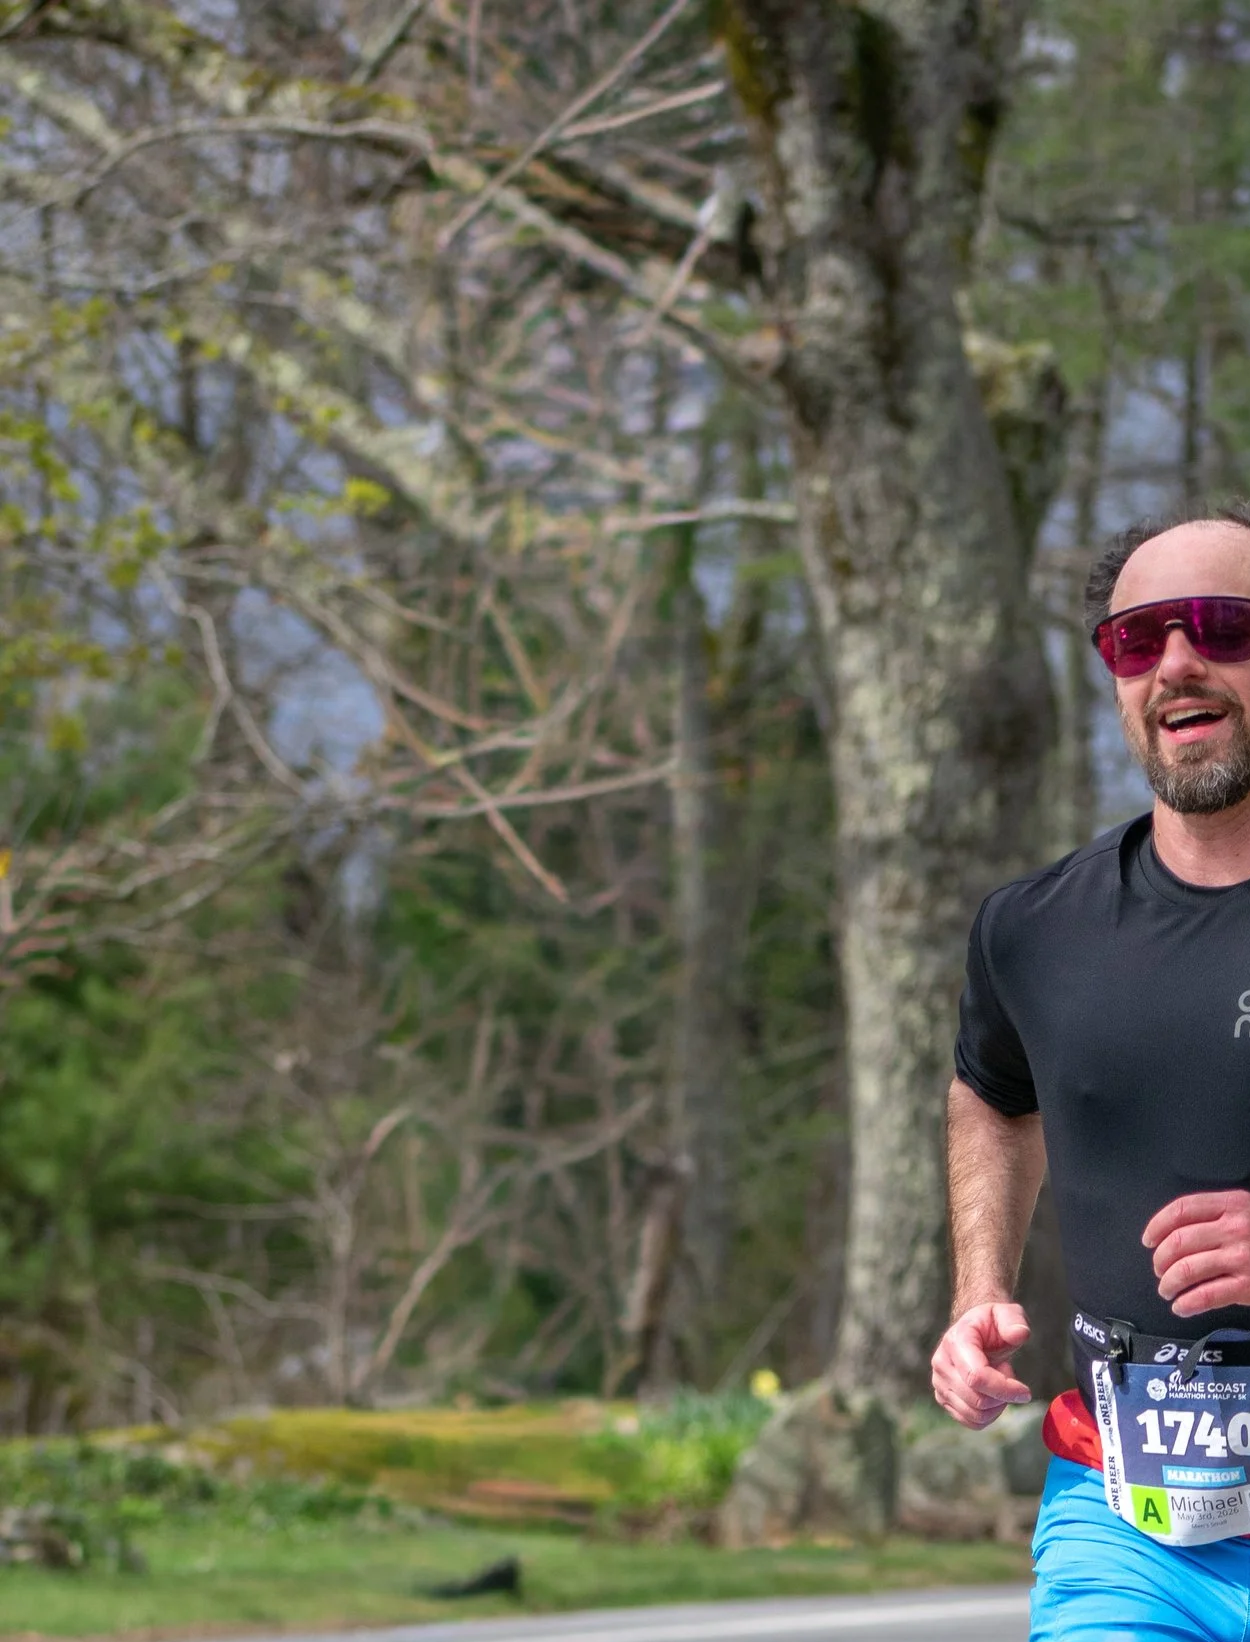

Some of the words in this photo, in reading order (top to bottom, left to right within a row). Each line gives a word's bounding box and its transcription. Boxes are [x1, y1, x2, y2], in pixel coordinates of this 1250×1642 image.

[1096, 1372, 1106, 1402] BEER
[1168, 1382, 1205, 1393] MAINE
[1207, 1382, 1247, 1393] COAST
[1168, 1392, 1206, 1400] MARATHON
[1100, 1403, 1112, 1426] ONE
[1108, 1455, 1118, 1485] BEER
[1166, 1469, 1241, 1483] MARATHON
[1111, 1487, 1121, 1511] ONE
[1170, 1491, 1244, 1512] Michael
[1142, 1497, 1164, 1525] A
[1177, 1512, 1195, 1522] May
[1216, 1508, 1240, 1519] 2026
